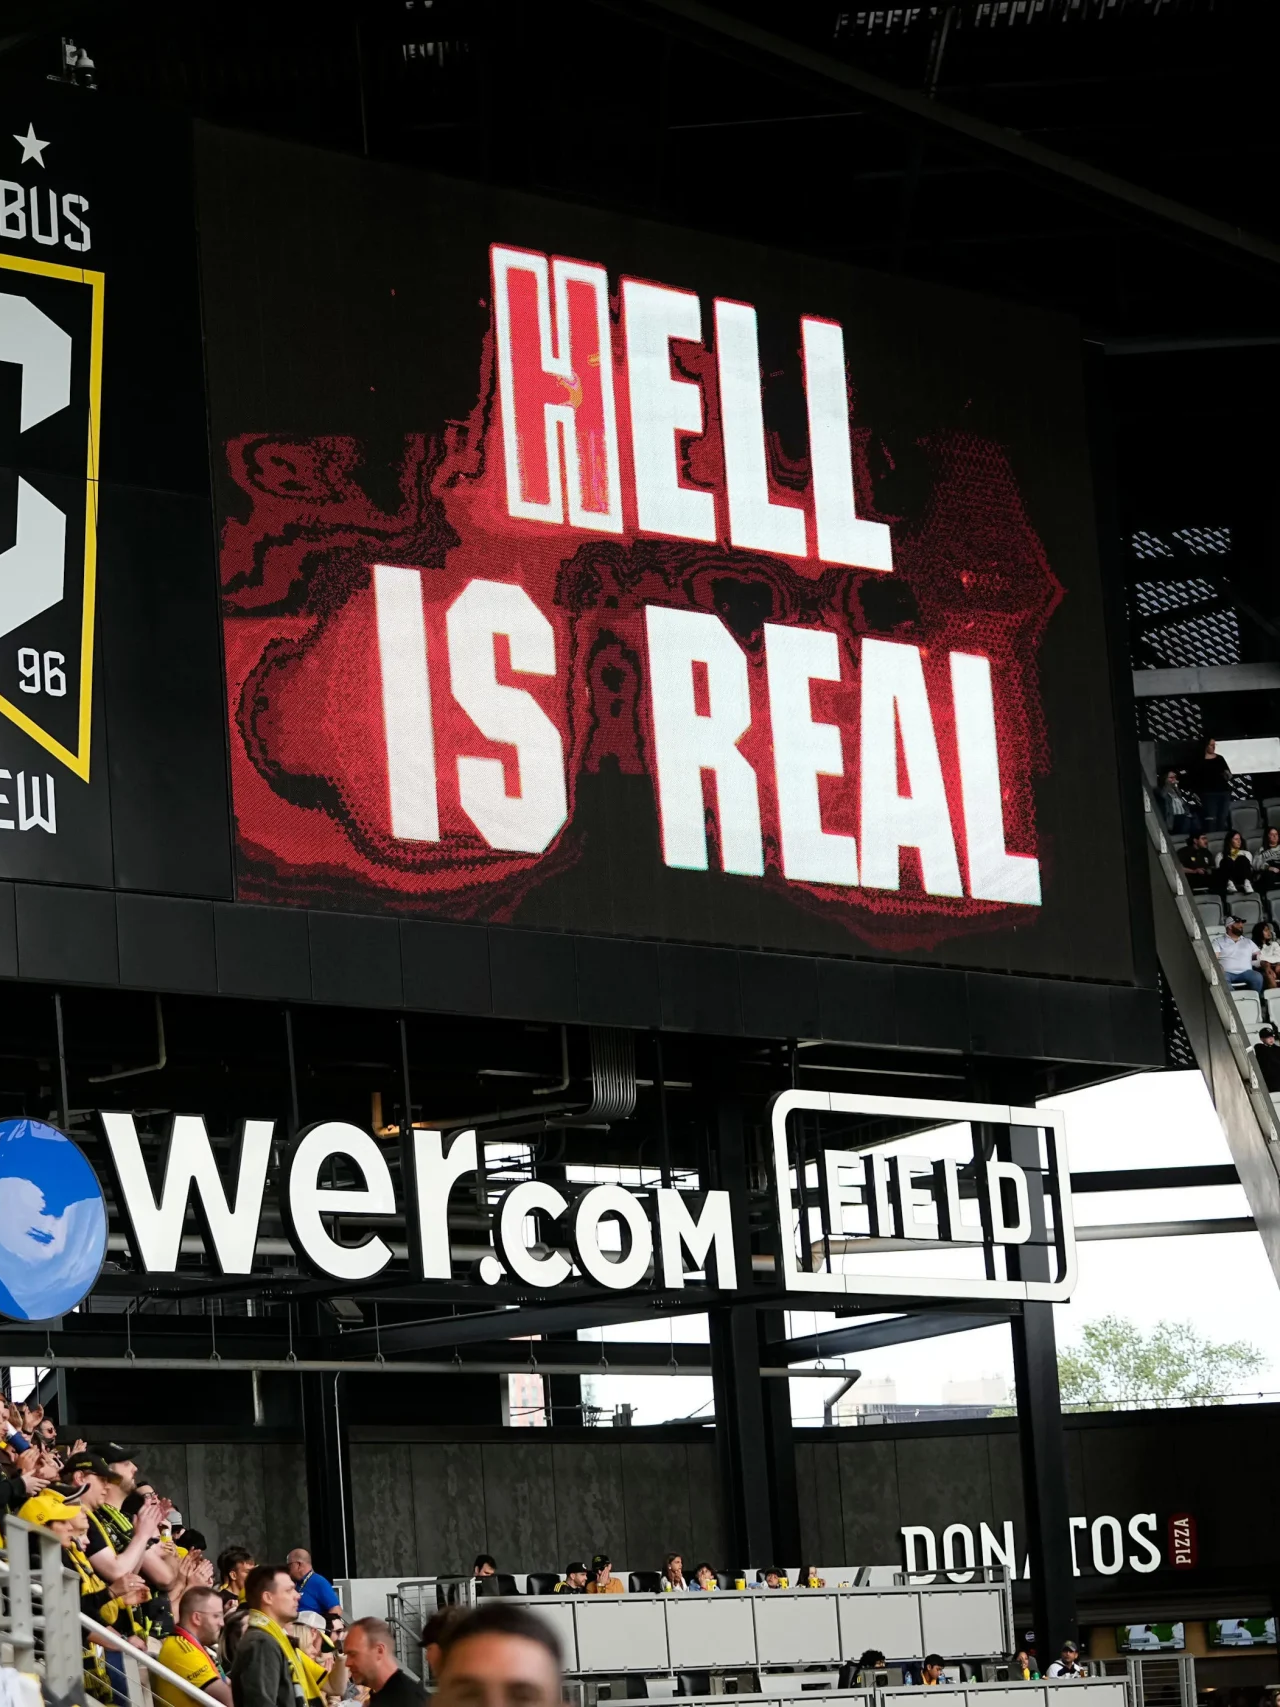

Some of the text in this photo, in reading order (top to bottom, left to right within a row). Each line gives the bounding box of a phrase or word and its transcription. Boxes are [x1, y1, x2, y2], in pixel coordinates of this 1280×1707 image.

[491, 244, 893, 571] HELL
[19, 648, 66, 697] 96
[374, 564, 1042, 906] IS REAL
[822, 1147, 1033, 1245] FIELD
[901, 1513, 1192, 1585] DONTOS PIZZA
